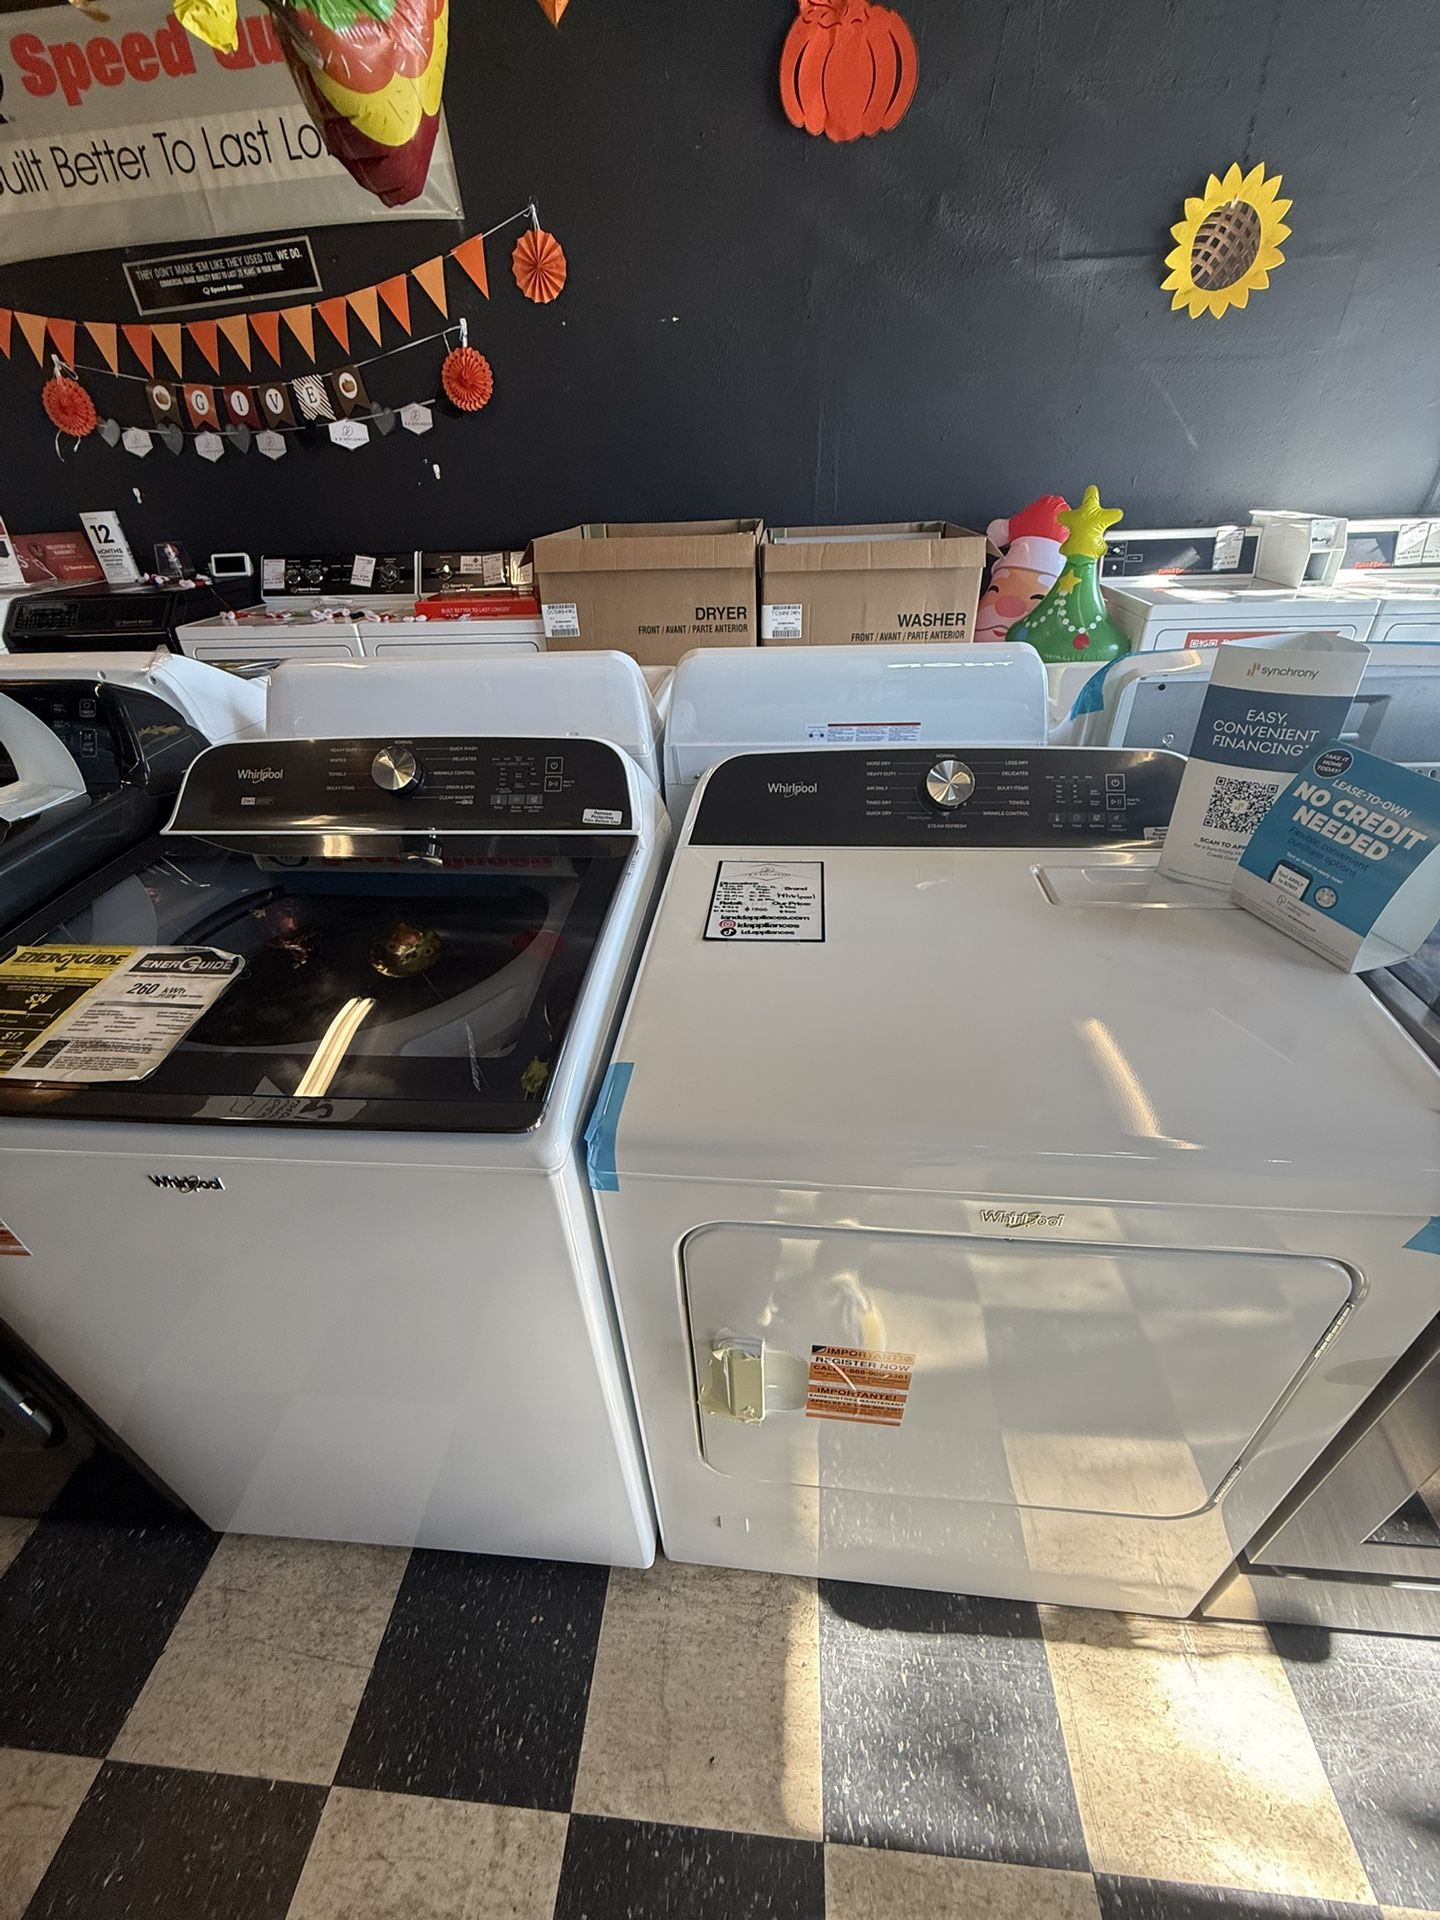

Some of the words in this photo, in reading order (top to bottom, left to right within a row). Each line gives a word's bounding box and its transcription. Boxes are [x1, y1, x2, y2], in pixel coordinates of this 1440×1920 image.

[9, 14, 197, 107] Speed
[50, 139, 150, 188] Better
[152, 132, 196, 176] To
[201, 119, 273, 170] Last
[278, 117, 331, 161] Lo
[135, 269, 154, 281] THEY
[154, 265, 174, 278] DON'T
[174, 263, 196, 276] MAKE
[208, 258, 225, 271] LIKE
[224, 256, 244, 268] THEY
[243, 252, 264, 266] USED
[275, 249, 290, 261] WE
[289, 247, 304, 260] DO.
[90, 524, 115, 544] 12
[695, 606, 748, 621] DRYER
[897, 612, 966, 628] WASHER
[638, 625, 661, 635] FRONT
[665, 625, 687, 634] AVANT
[692, 624, 713, 633] PARTE
[714, 623, 748, 633] ANTERIOR
[851, 632, 874, 642] FRONT
[879, 632, 901, 641] AVANT
[907, 631, 929, 640] PARTE
[930, 629, 965, 639] ANTERIOR
[1261, 664, 1320, 680] synchrony
[1246, 708, 1288, 728] EASY,
[1213, 719, 1320, 743] CONVENIENT
[1322, 759, 1344, 768] HOME
[1325, 753, 1341, 761] TAKE
[237, 766, 284, 784] Whirlpool
[767, 781, 818, 798] Whirlpool
[1292, 780, 1331, 808] NO
[1332, 798, 1428, 851] CREDIT
[1199, 837, 1220, 845] SCAN
[1288, 875, 1304, 888] APPLY
[13, 951, 130, 972] ENERGYGUIDE
[139, 956, 233, 972] ENERGUIDE
[126, 983, 160, 995] 260
[148, 1174, 226, 1194] Whirlpool
[979, 1208, 1065, 1229] Whirlpool
[815, 1356, 877, 1369] REGISTER
[879, 1361, 911, 1372] NOW
[859, 1398, 904, 1407] MAINTENANT
